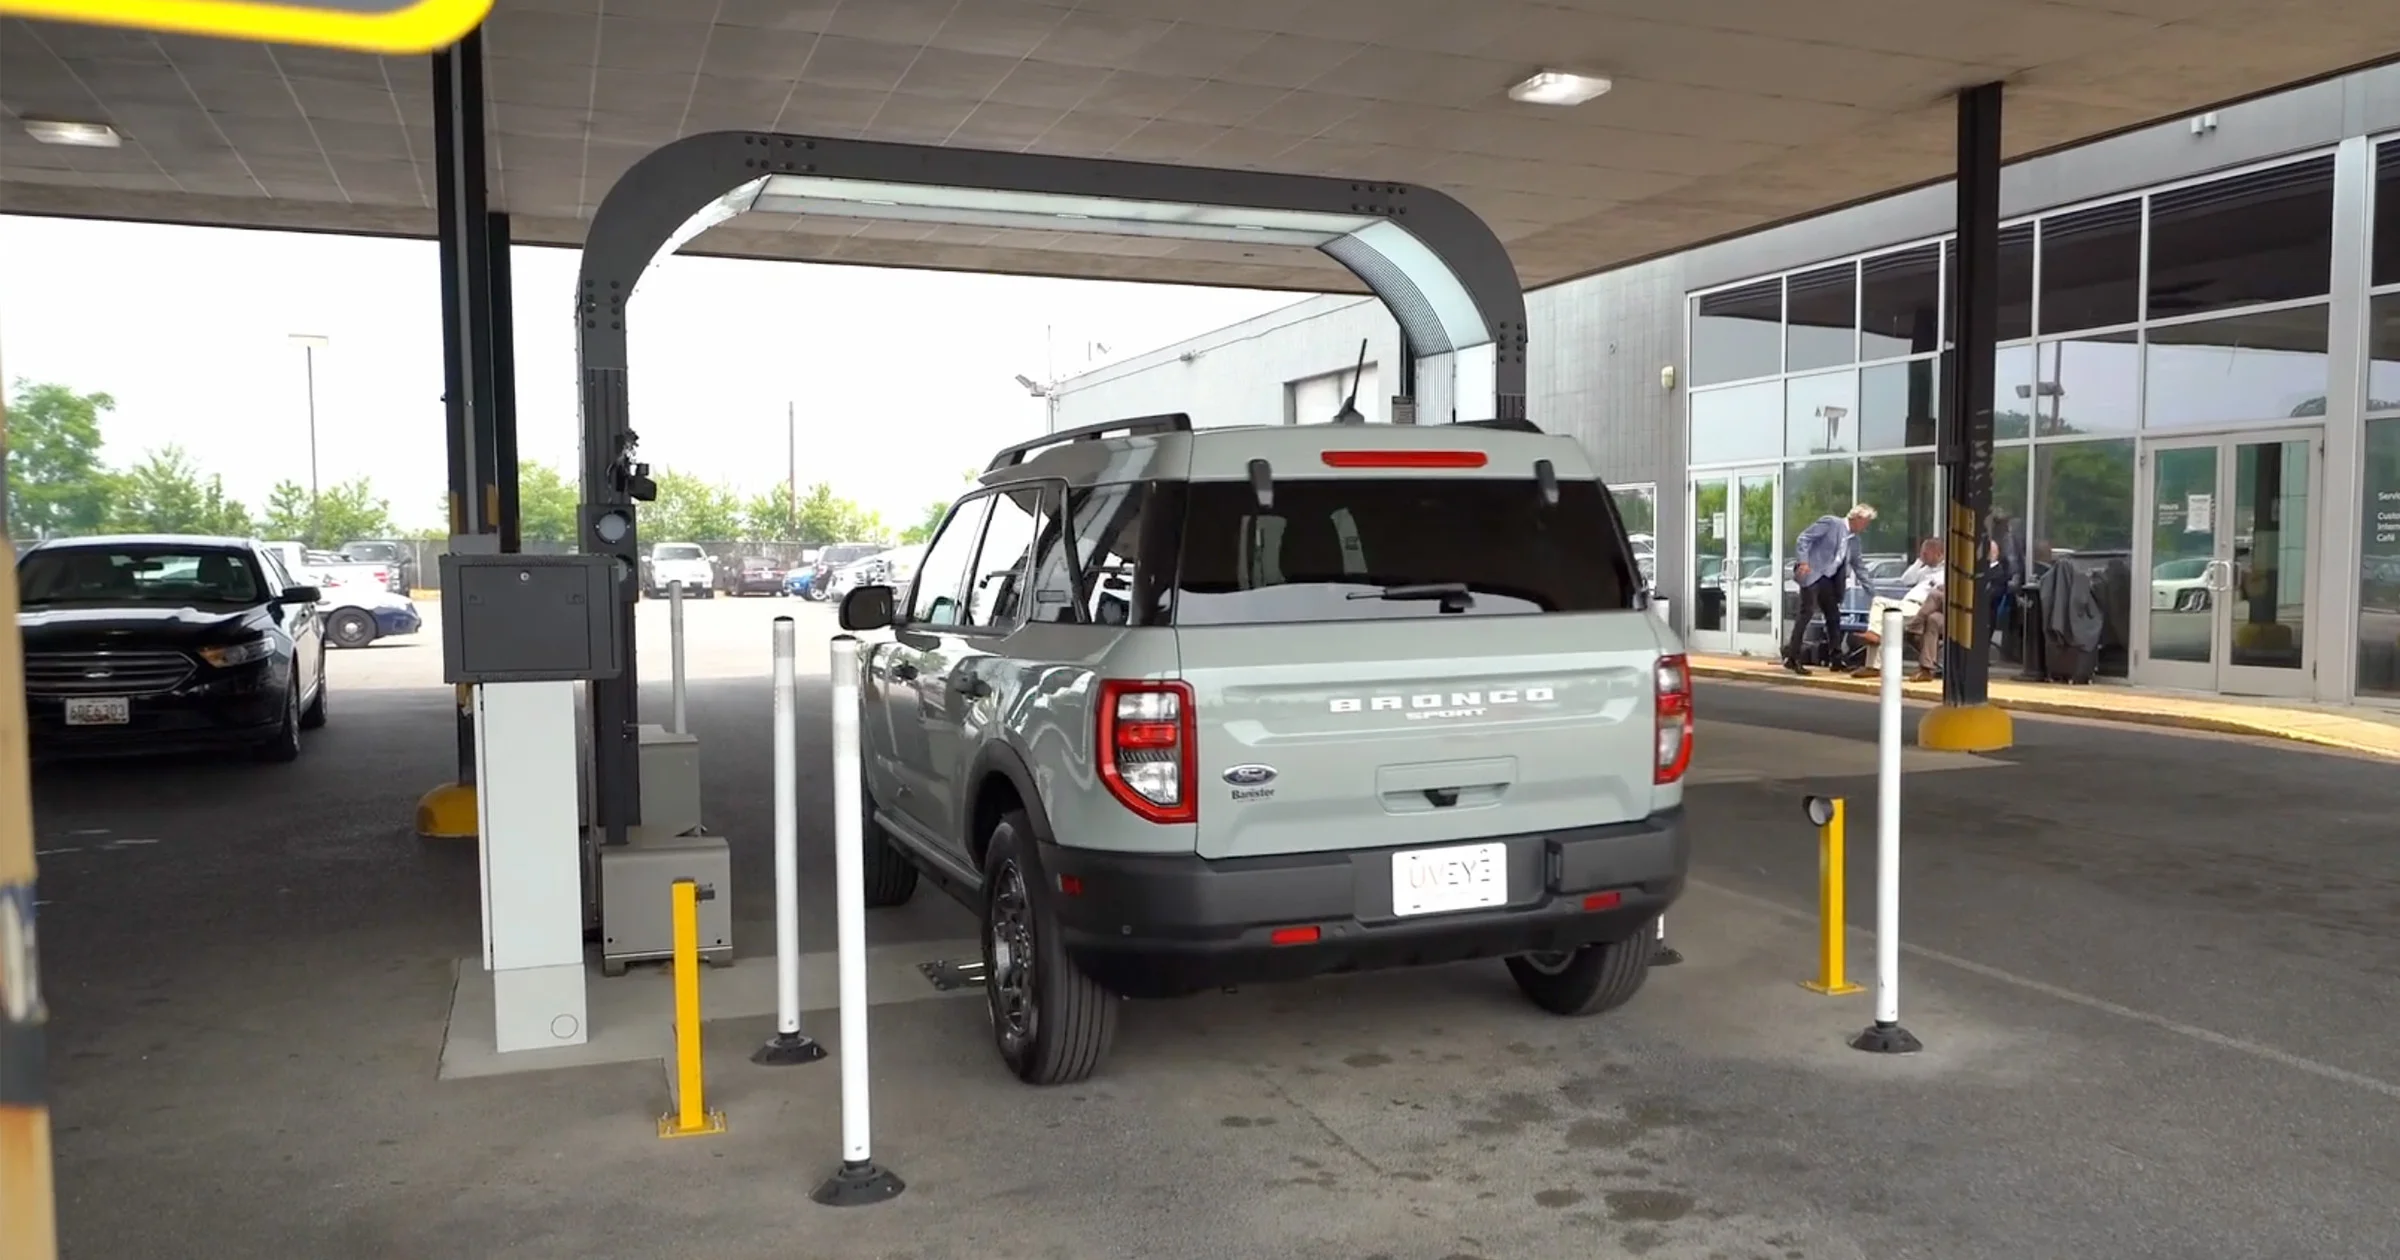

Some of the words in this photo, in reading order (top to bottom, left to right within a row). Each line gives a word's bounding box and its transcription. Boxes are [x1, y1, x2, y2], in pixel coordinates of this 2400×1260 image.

[1329, 687, 1555, 713] BRONCO
[1405, 707, 1488, 721] SPORT
[1231, 788, 1275, 800] Banister
[1409, 858, 1491, 889] UVEYE
